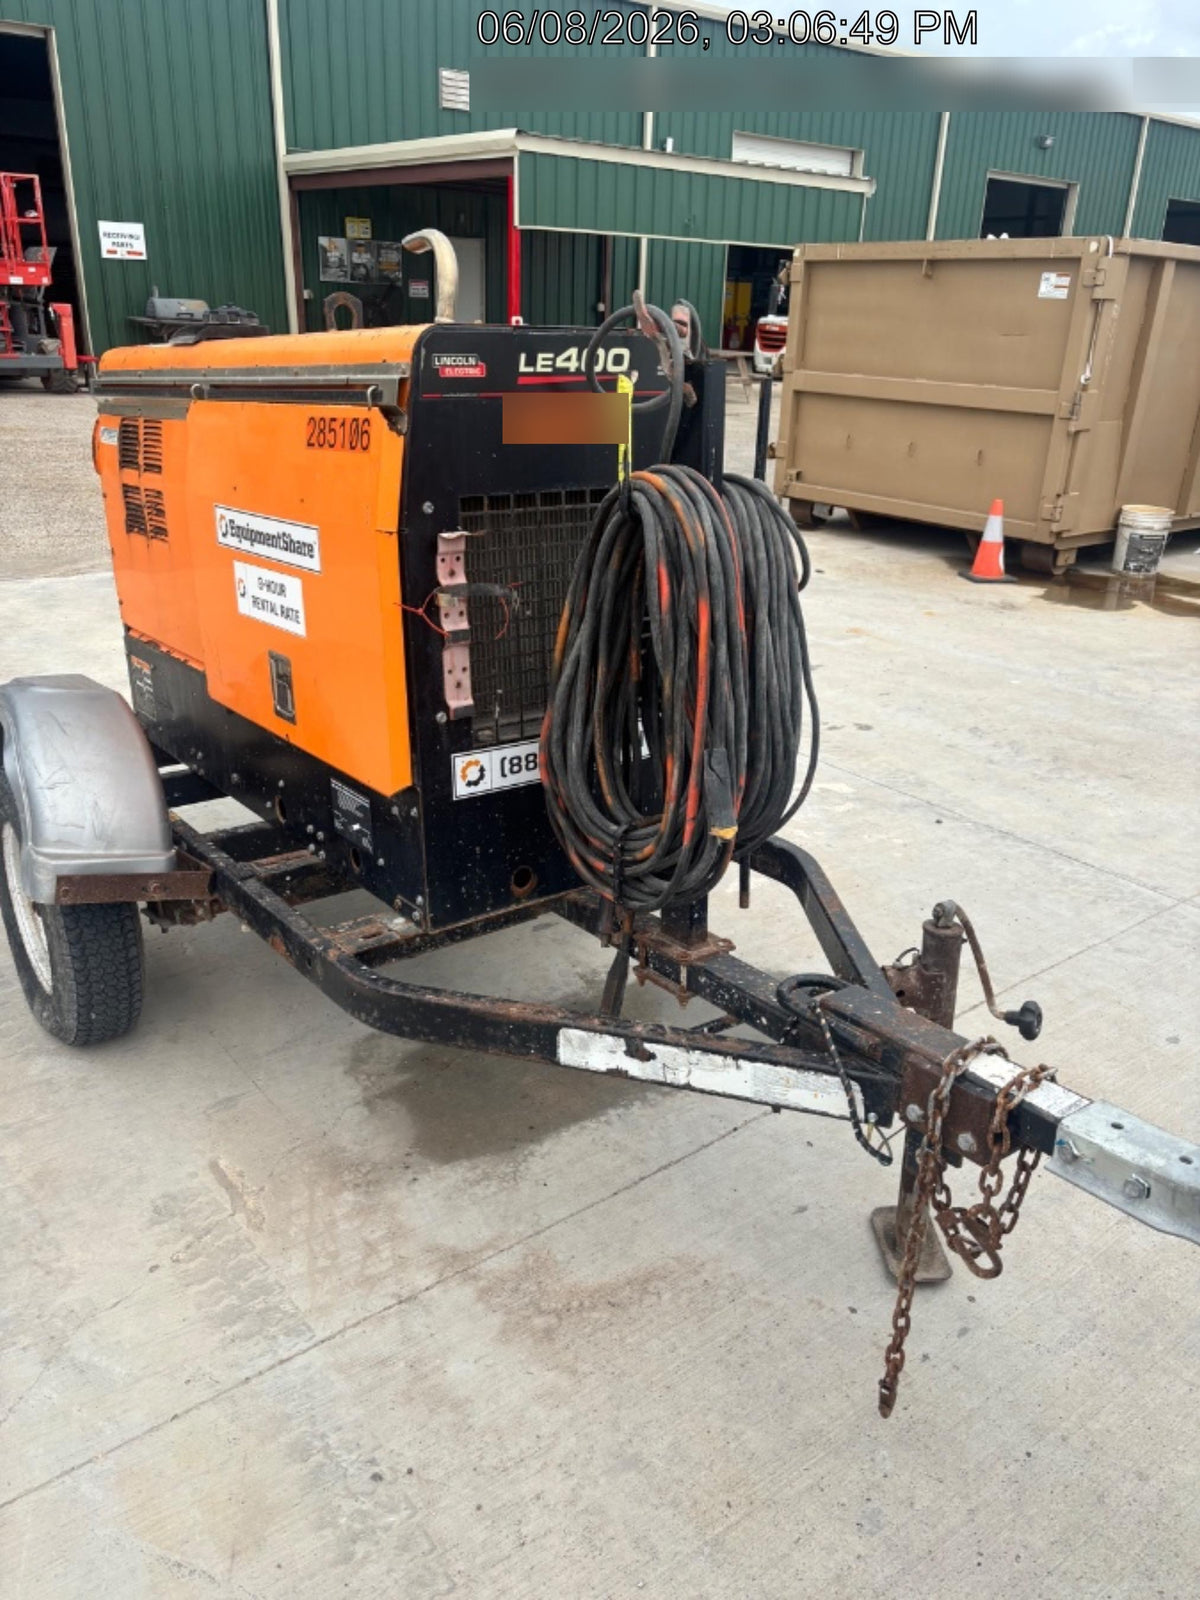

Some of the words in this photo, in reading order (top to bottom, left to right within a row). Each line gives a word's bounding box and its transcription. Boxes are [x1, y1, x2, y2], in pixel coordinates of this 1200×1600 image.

[111, 241, 134, 249] PARTS
[434, 356, 476, 366] LINCOLN
[445, 367, 482, 377] ELECTRIC
[518, 347, 630, 373] LE400
[307, 416, 370, 451] 285106
[229, 518, 315, 559] EquipmentShare
[251, 595, 279, 617] RENTAL
[280, 604, 301, 625] RATE
